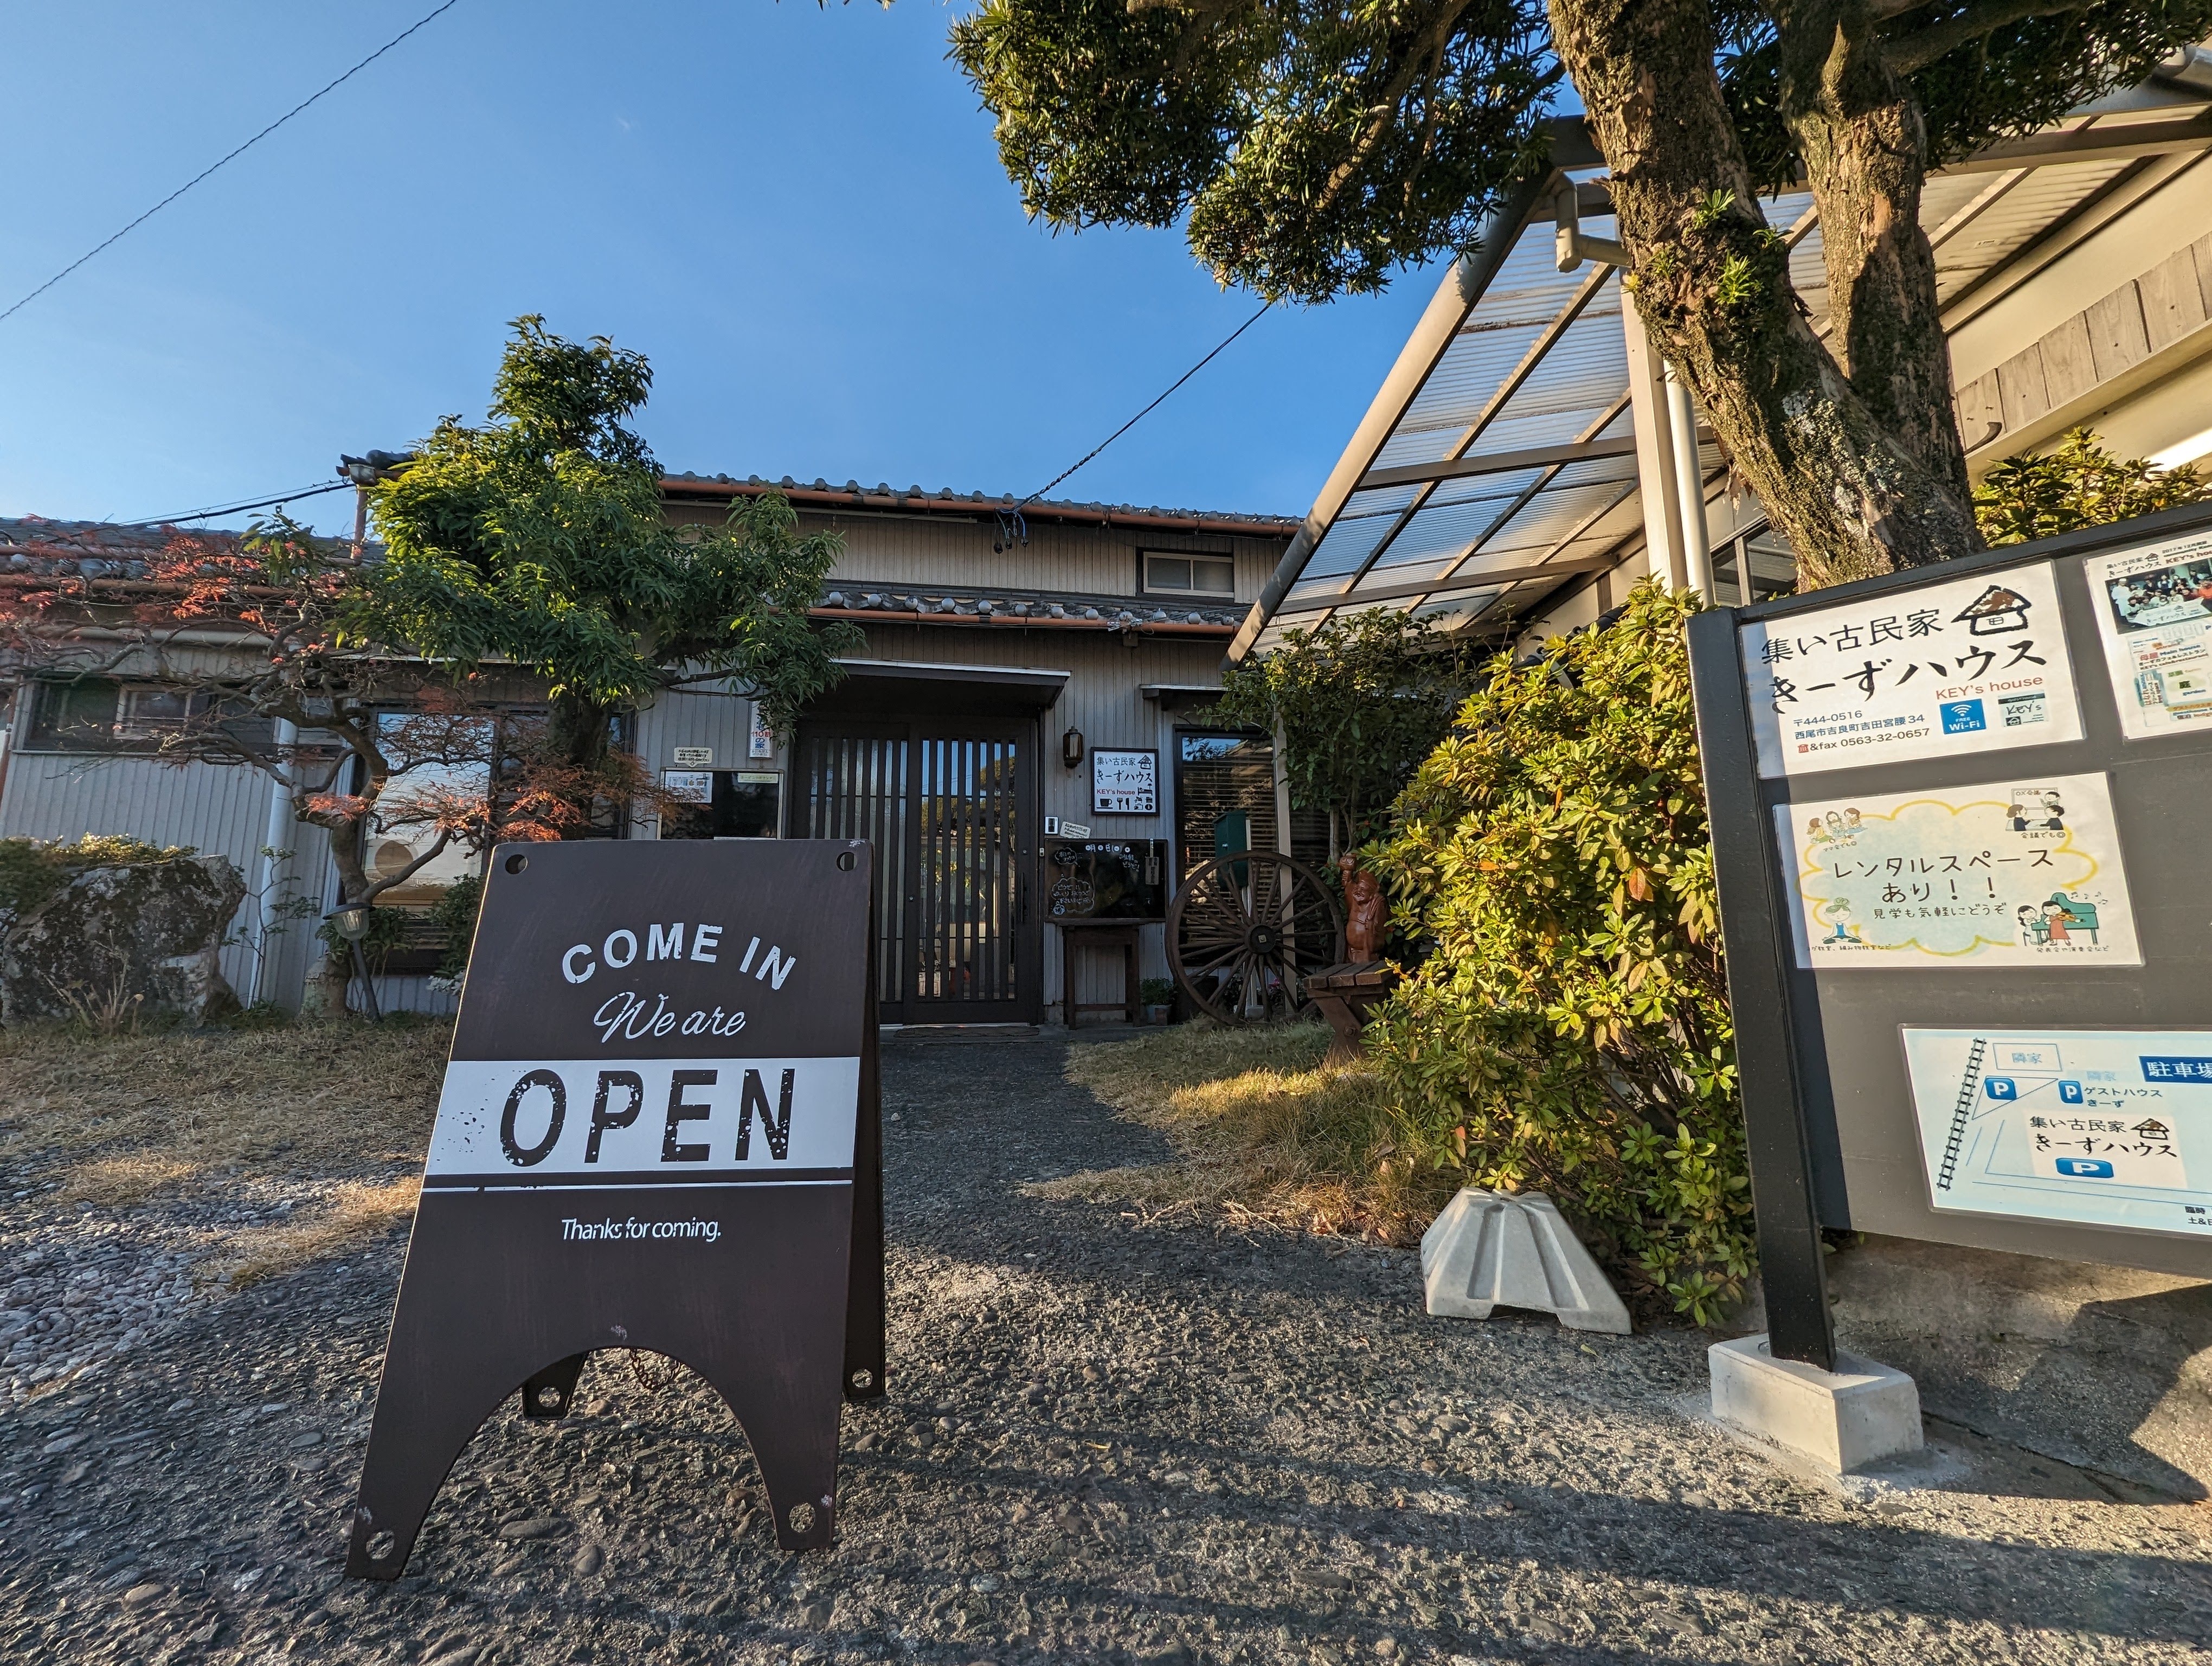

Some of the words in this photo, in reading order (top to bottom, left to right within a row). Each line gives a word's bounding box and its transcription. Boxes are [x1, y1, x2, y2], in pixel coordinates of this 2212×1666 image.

[2108, 561, 2162, 578] きーずハウス
[1761, 608, 1944, 664] 集い古民家
[1771, 639, 2047, 714] きーずハウス
[1989, 677, 2043, 691] house
[1949, 720, 1980, 731] Wi-Fi
[1841, 728, 1930, 747] 0563-32-0657
[1097, 756, 1136, 766] 集い古民家
[1097, 768, 1153, 784] きーずハウス
[1834, 849, 2053, 879] レンタルスペース
[1874, 902, 2007, 919] 見学も気軽にどうぞ
[562, 922, 723, 984] COME
[740, 937, 797, 991] IN
[593, 991, 676, 1044] We
[681, 1005, 747, 1036] are
[1995, 1081, 2009, 1095] P
[2065, 1085, 2077, 1099] P
[2084, 1087, 2163, 1098] ゲストハウス
[500, 1068, 796, 1168] OPEN
[2029, 1115, 2127, 1133] 集い古民家
[2035, 1133, 2177, 1158] きーずハウス
[561, 1218, 622, 1240] Thanks
[625, 1216, 651, 1239] for
[652, 1217, 722, 1243] coming.
